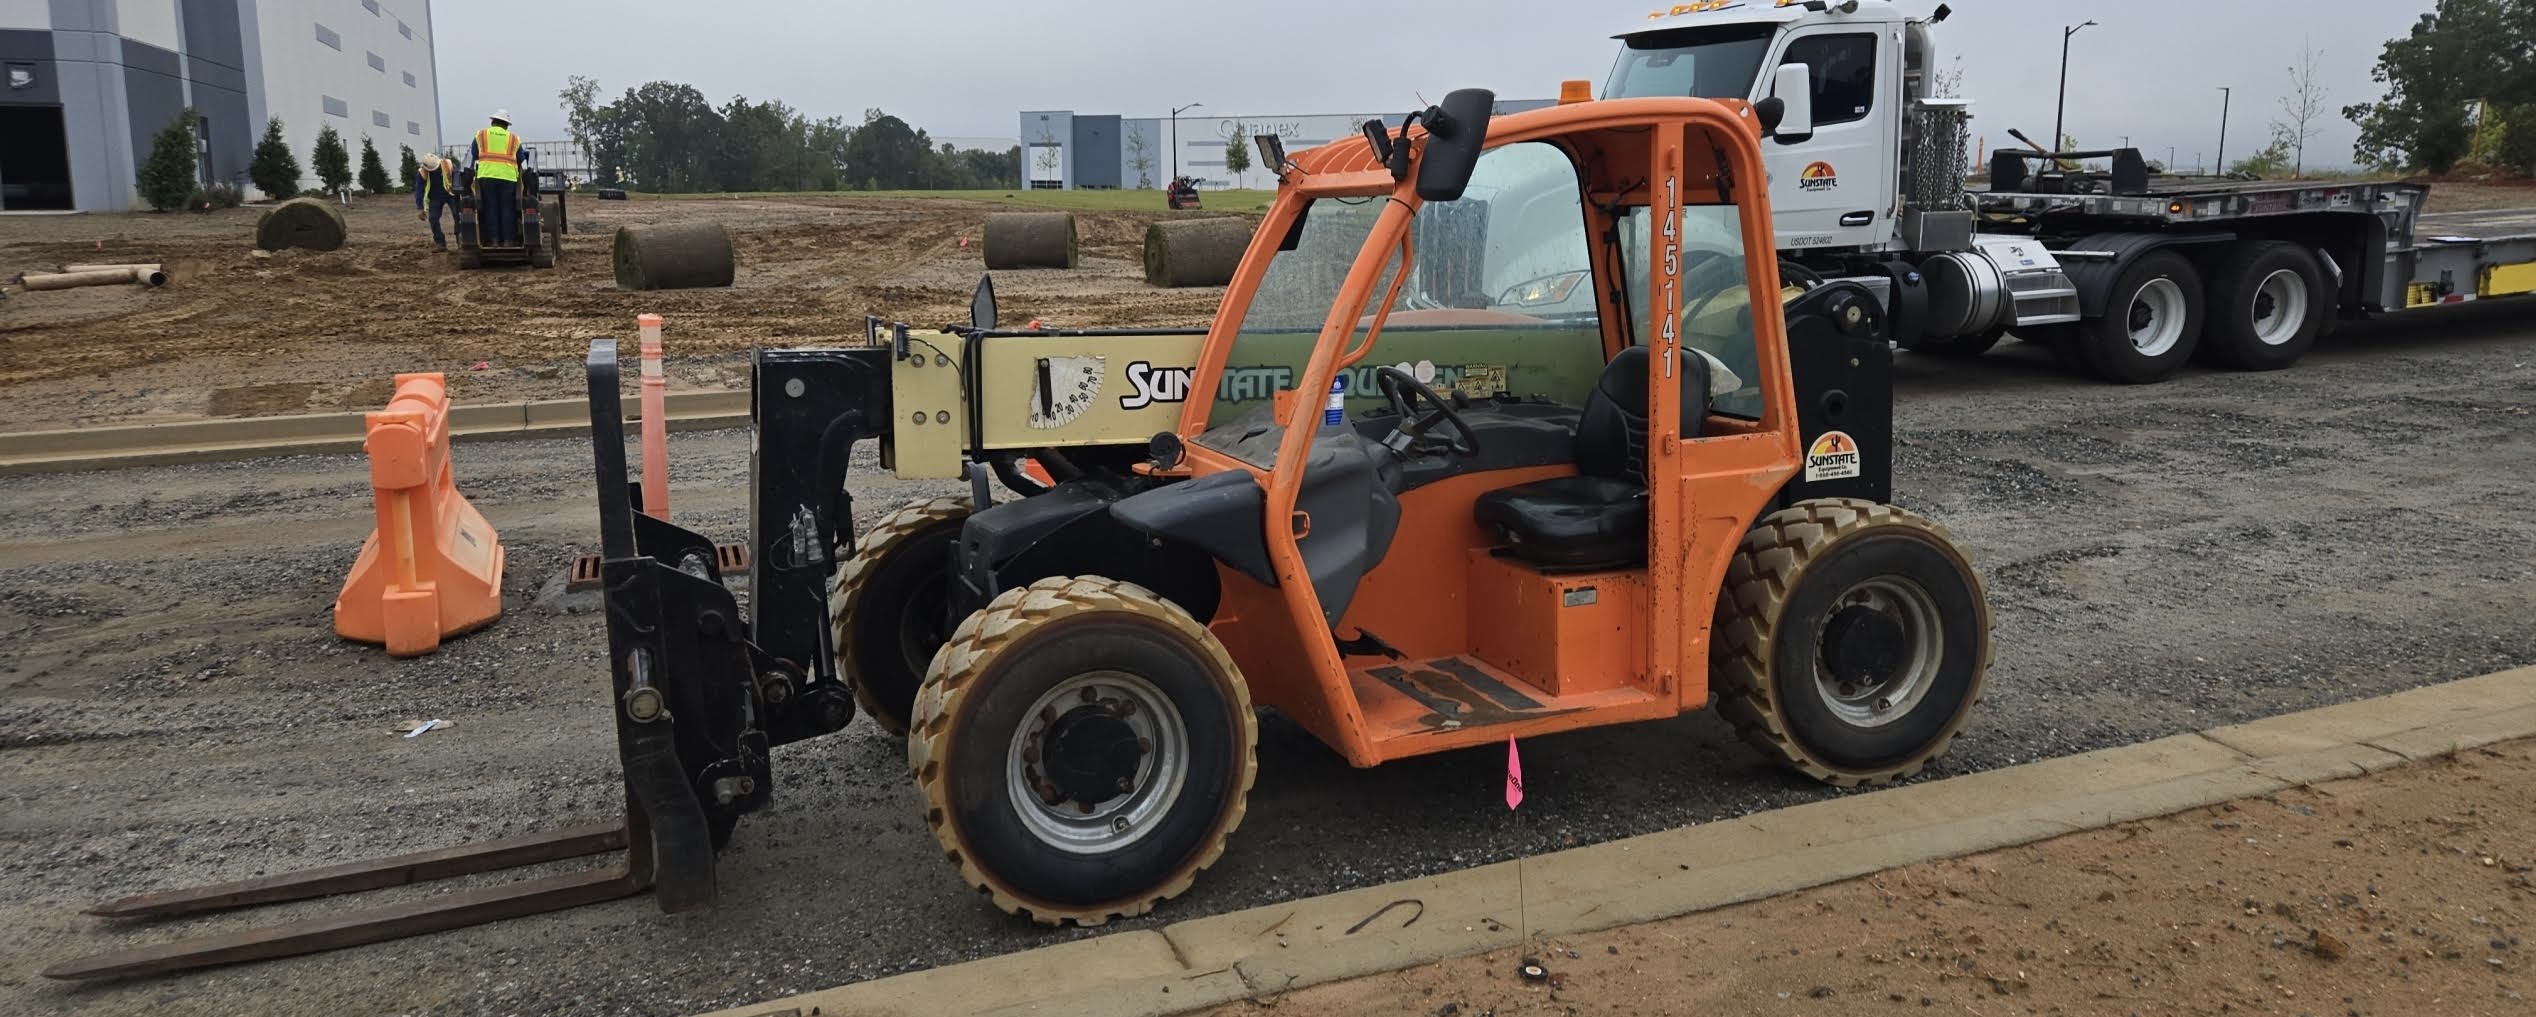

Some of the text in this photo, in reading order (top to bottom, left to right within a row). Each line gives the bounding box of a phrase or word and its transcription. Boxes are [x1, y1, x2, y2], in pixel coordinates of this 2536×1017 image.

[1216, 119, 1300, 140] Quanex
[1800, 178, 1837, 188] SUNSTATE
[1791, 236, 1812, 246] USDOT
[1662, 176, 1678, 378] 145141
[1083, 366, 1093, 375] 80
[1087, 375, 1097, 385] 70
[1119, 361, 1293, 410] SUNTATE
[1069, 394, 1079, 403] 40
[1078, 392, 1089, 403] 50
[1055, 402, 1064, 413] 20
[1065, 404, 1074, 415] 30
[1809, 453, 1857, 468] SUNSTATE
